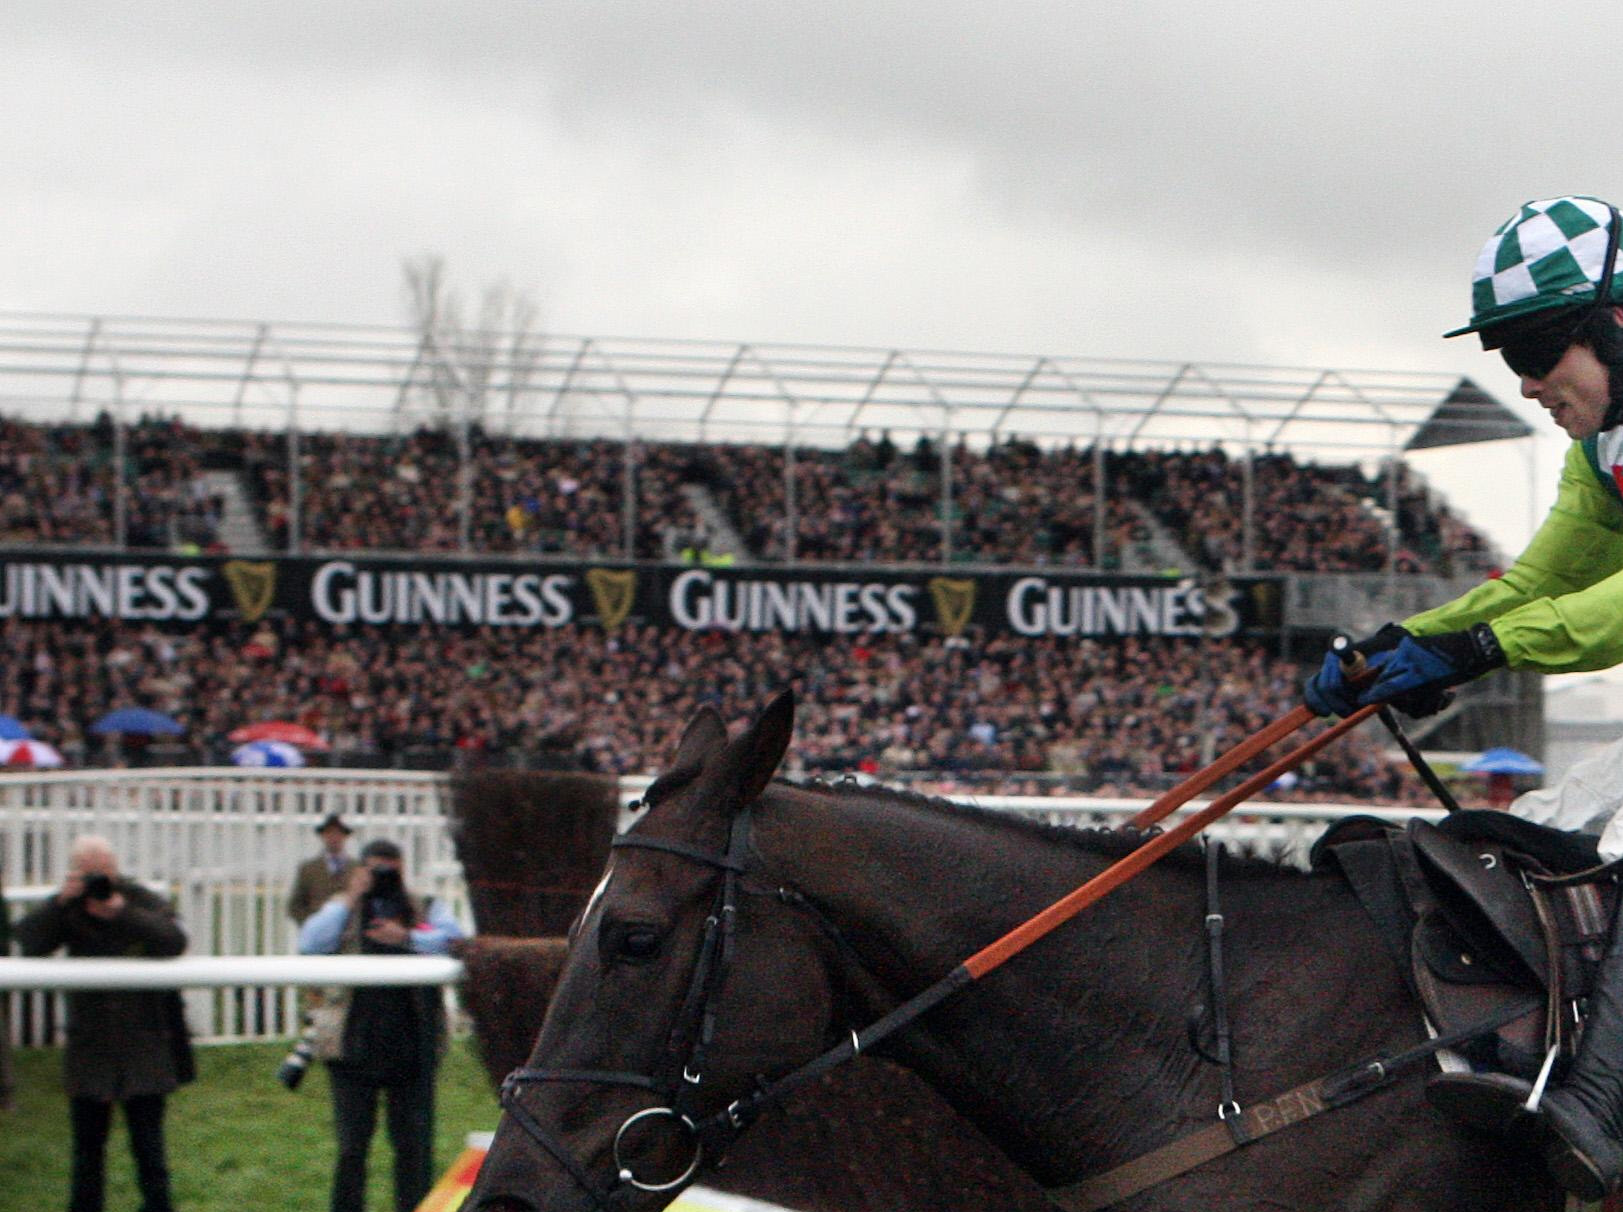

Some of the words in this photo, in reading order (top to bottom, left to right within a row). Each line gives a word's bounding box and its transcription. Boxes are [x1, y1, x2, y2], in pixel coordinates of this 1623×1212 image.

[311, 561, 575, 627] GUINNESS
[669, 569, 918, 633] GUINNESS
[1006, 576, 1240, 638] GUINNESS
